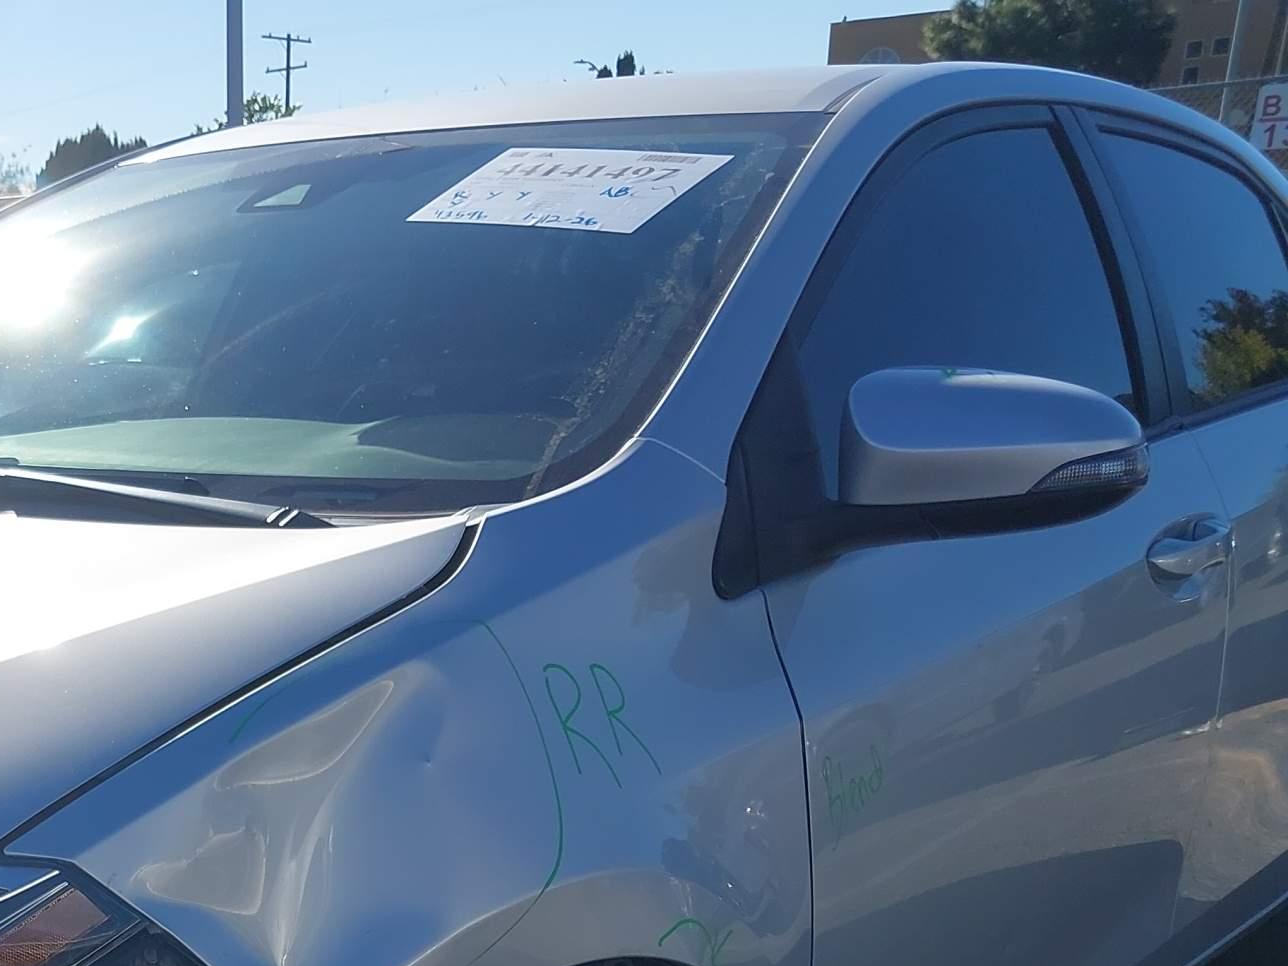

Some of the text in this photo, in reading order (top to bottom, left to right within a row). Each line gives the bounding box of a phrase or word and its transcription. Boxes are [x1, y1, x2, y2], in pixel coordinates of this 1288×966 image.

[1262, 95, 1282, 117] B
[496, 162, 682, 182] 44141497
[543, 661, 663, 789] RR
